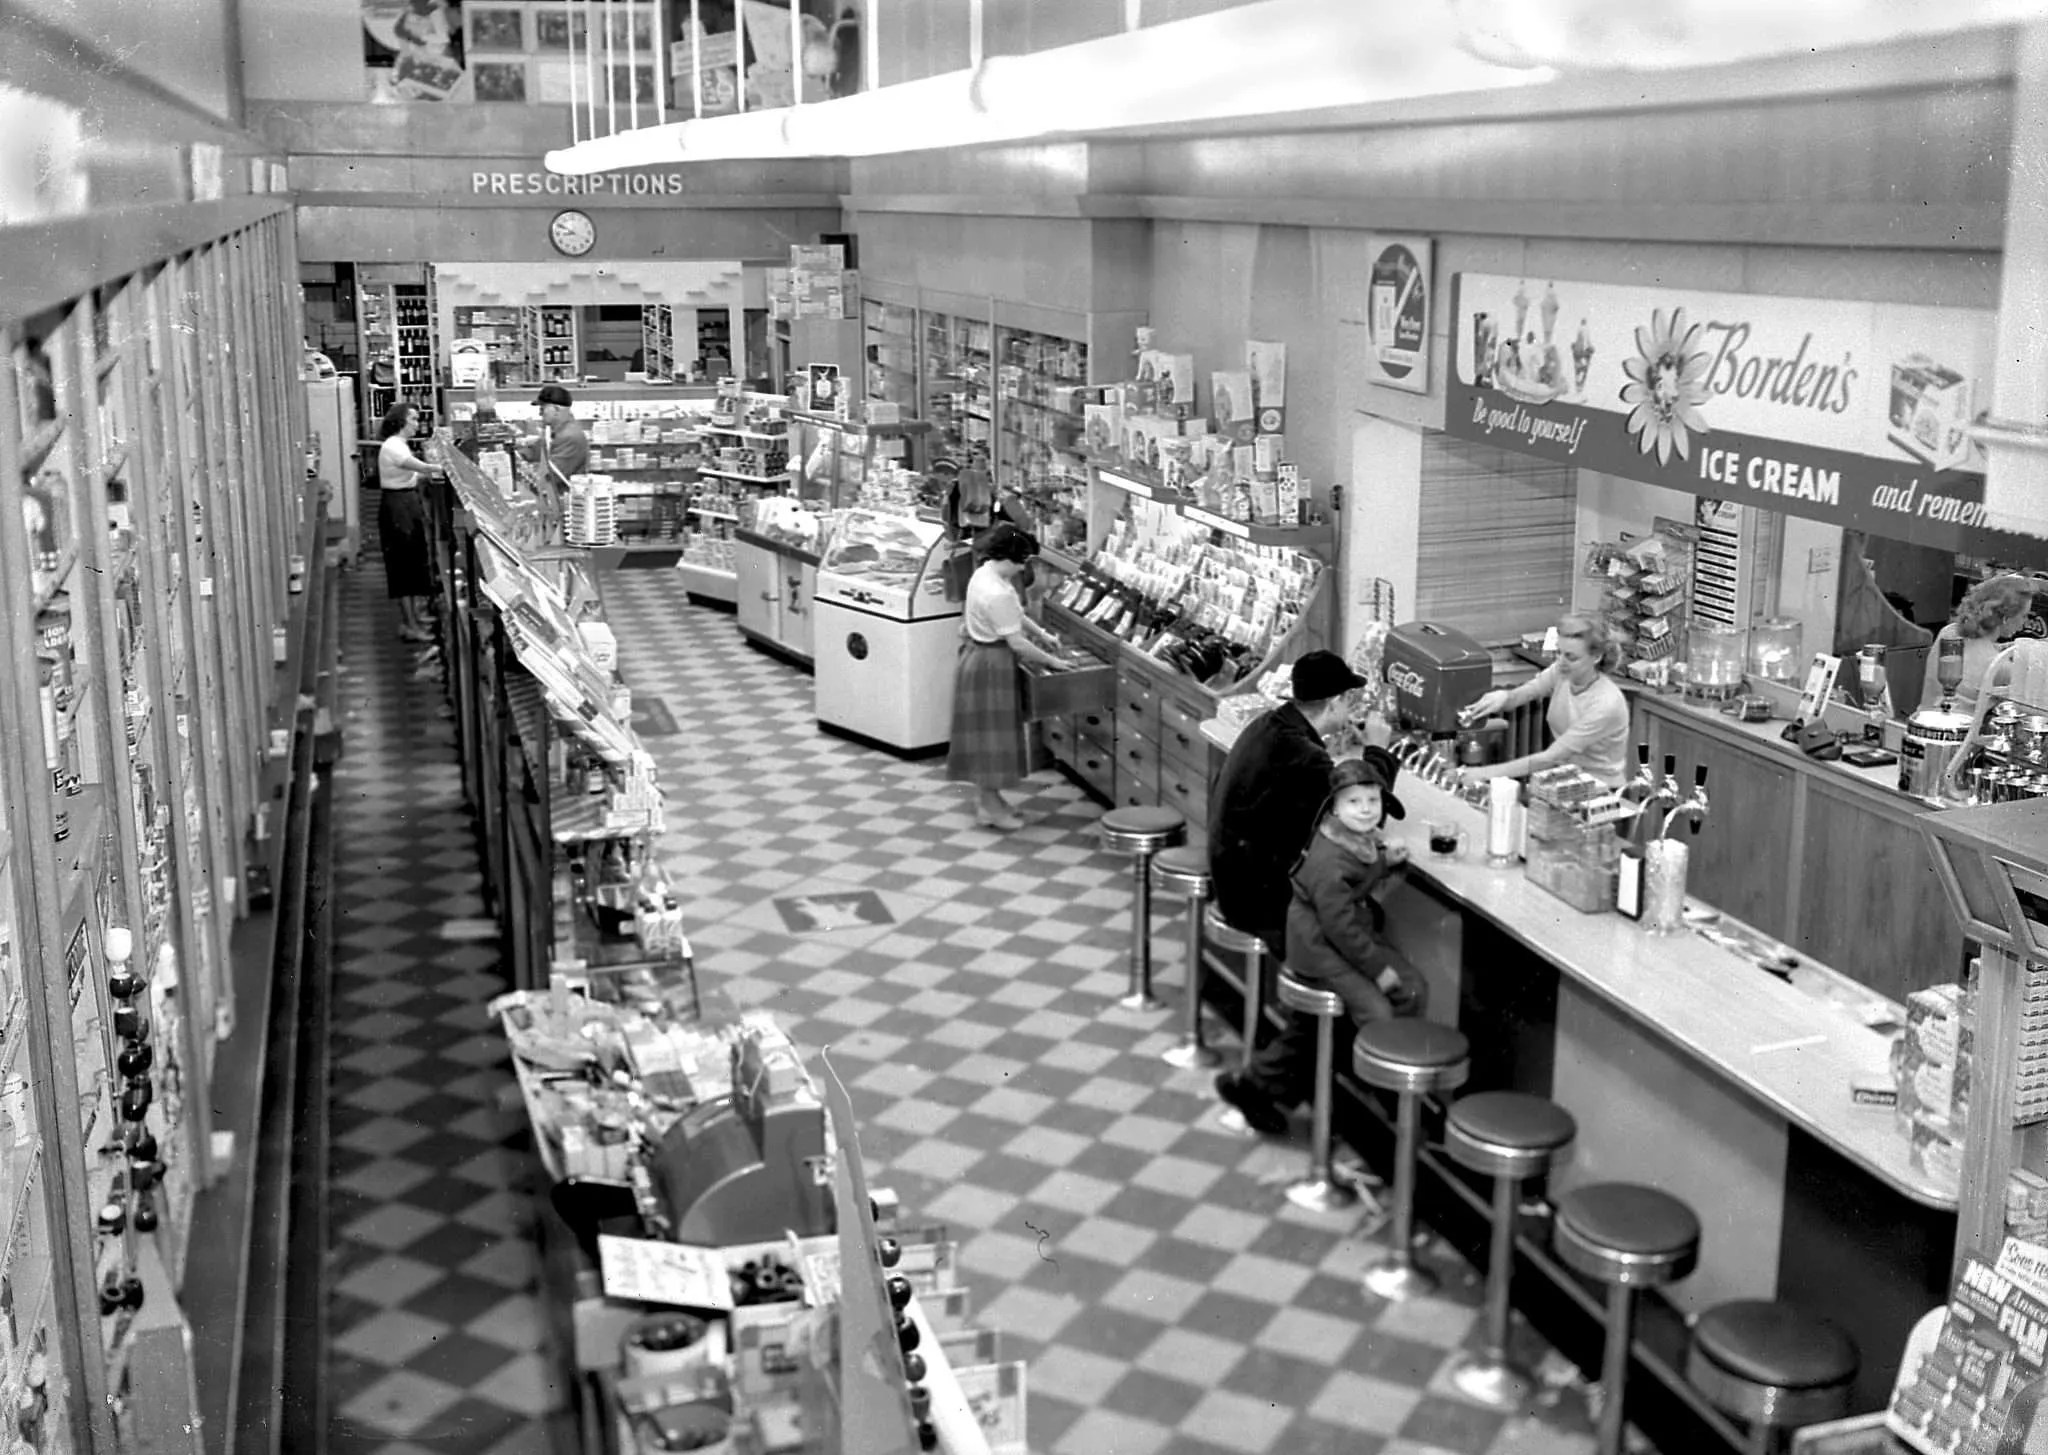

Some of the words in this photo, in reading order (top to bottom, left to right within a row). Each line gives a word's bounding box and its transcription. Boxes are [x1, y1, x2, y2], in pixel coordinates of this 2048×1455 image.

[472, 172, 683, 195] PRESCRIPTIONS
[1703, 320, 1859, 414] Borden's
[1472, 396, 1486, 425] Be
[1486, 404, 1519, 434] good
[1517, 408, 1530, 434] to
[1528, 416, 1588, 455] yourself
[1700, 447, 1741, 484] ICE
[1746, 456, 1841, 506] CREAM
[1871, 478, 1918, 514] and
[1963, 1258, 2013, 1304] NEW
[1998, 1304, 2048, 1356] FILM
